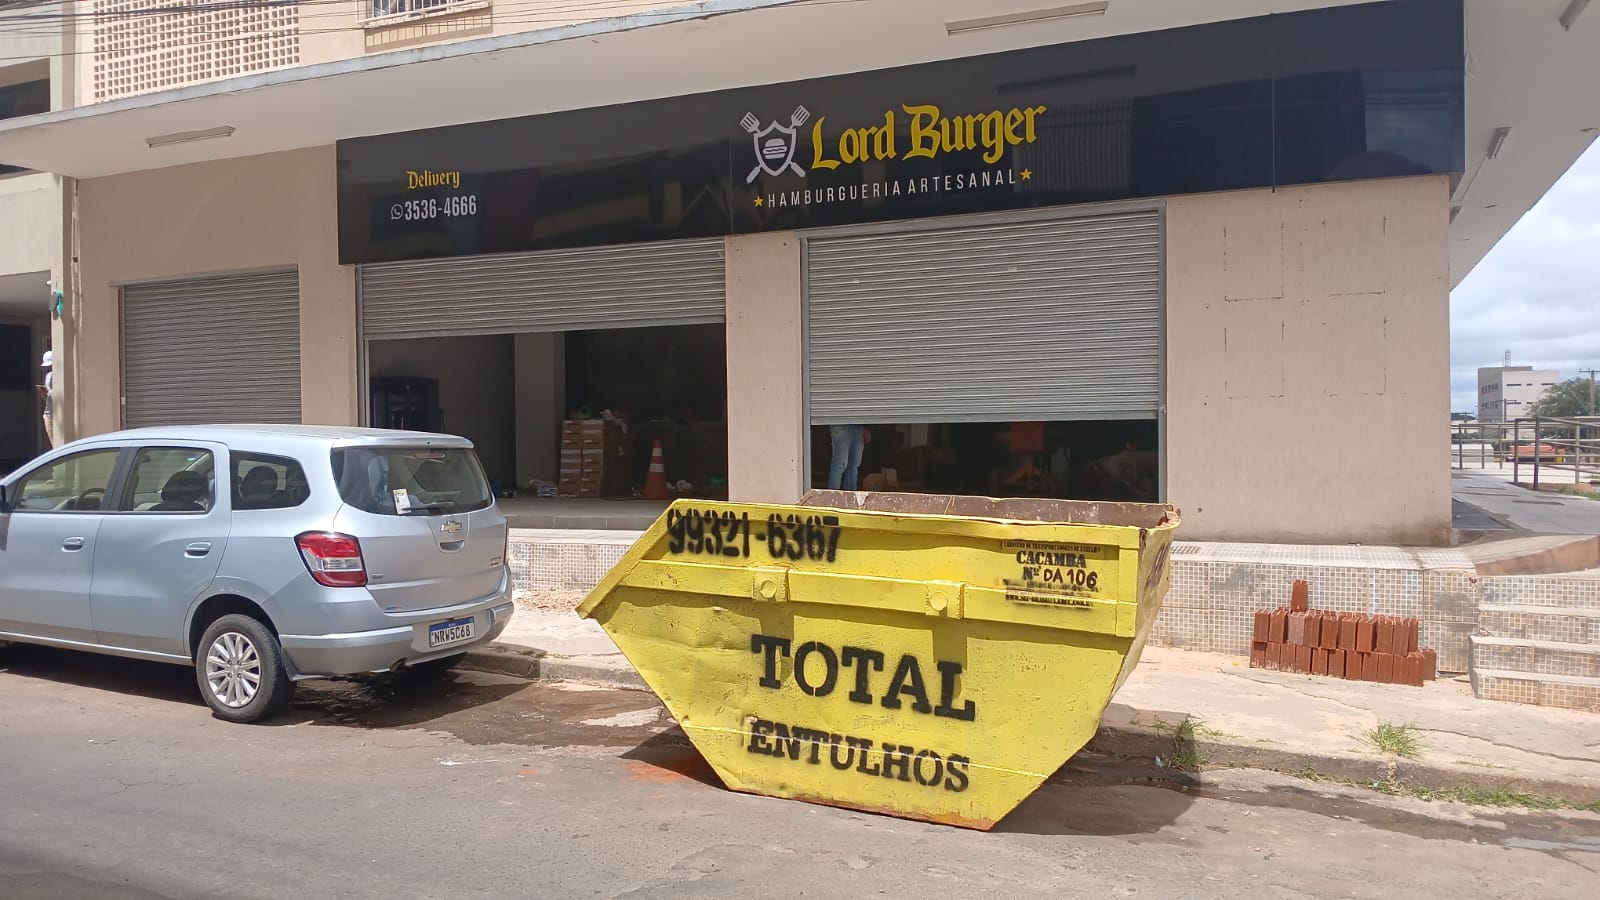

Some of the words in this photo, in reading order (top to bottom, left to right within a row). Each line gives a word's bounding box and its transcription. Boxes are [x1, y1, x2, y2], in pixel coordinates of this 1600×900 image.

[810, 109, 897, 170] Lord
[902, 103, 1047, 165] Burger
[406, 170, 461, 190] Delivery
[767, 180, 901, 209] HAMBURGUERIA
[907, 168, 1017, 195] ARTESANAL
[404, 195, 477, 221] 3536-4666
[1043, 568, 1064, 584] DA
[1066, 568, 1098, 589] 106
[751, 634, 976, 722] TOTAL
[747, 718, 970, 793] ENTULHOS
